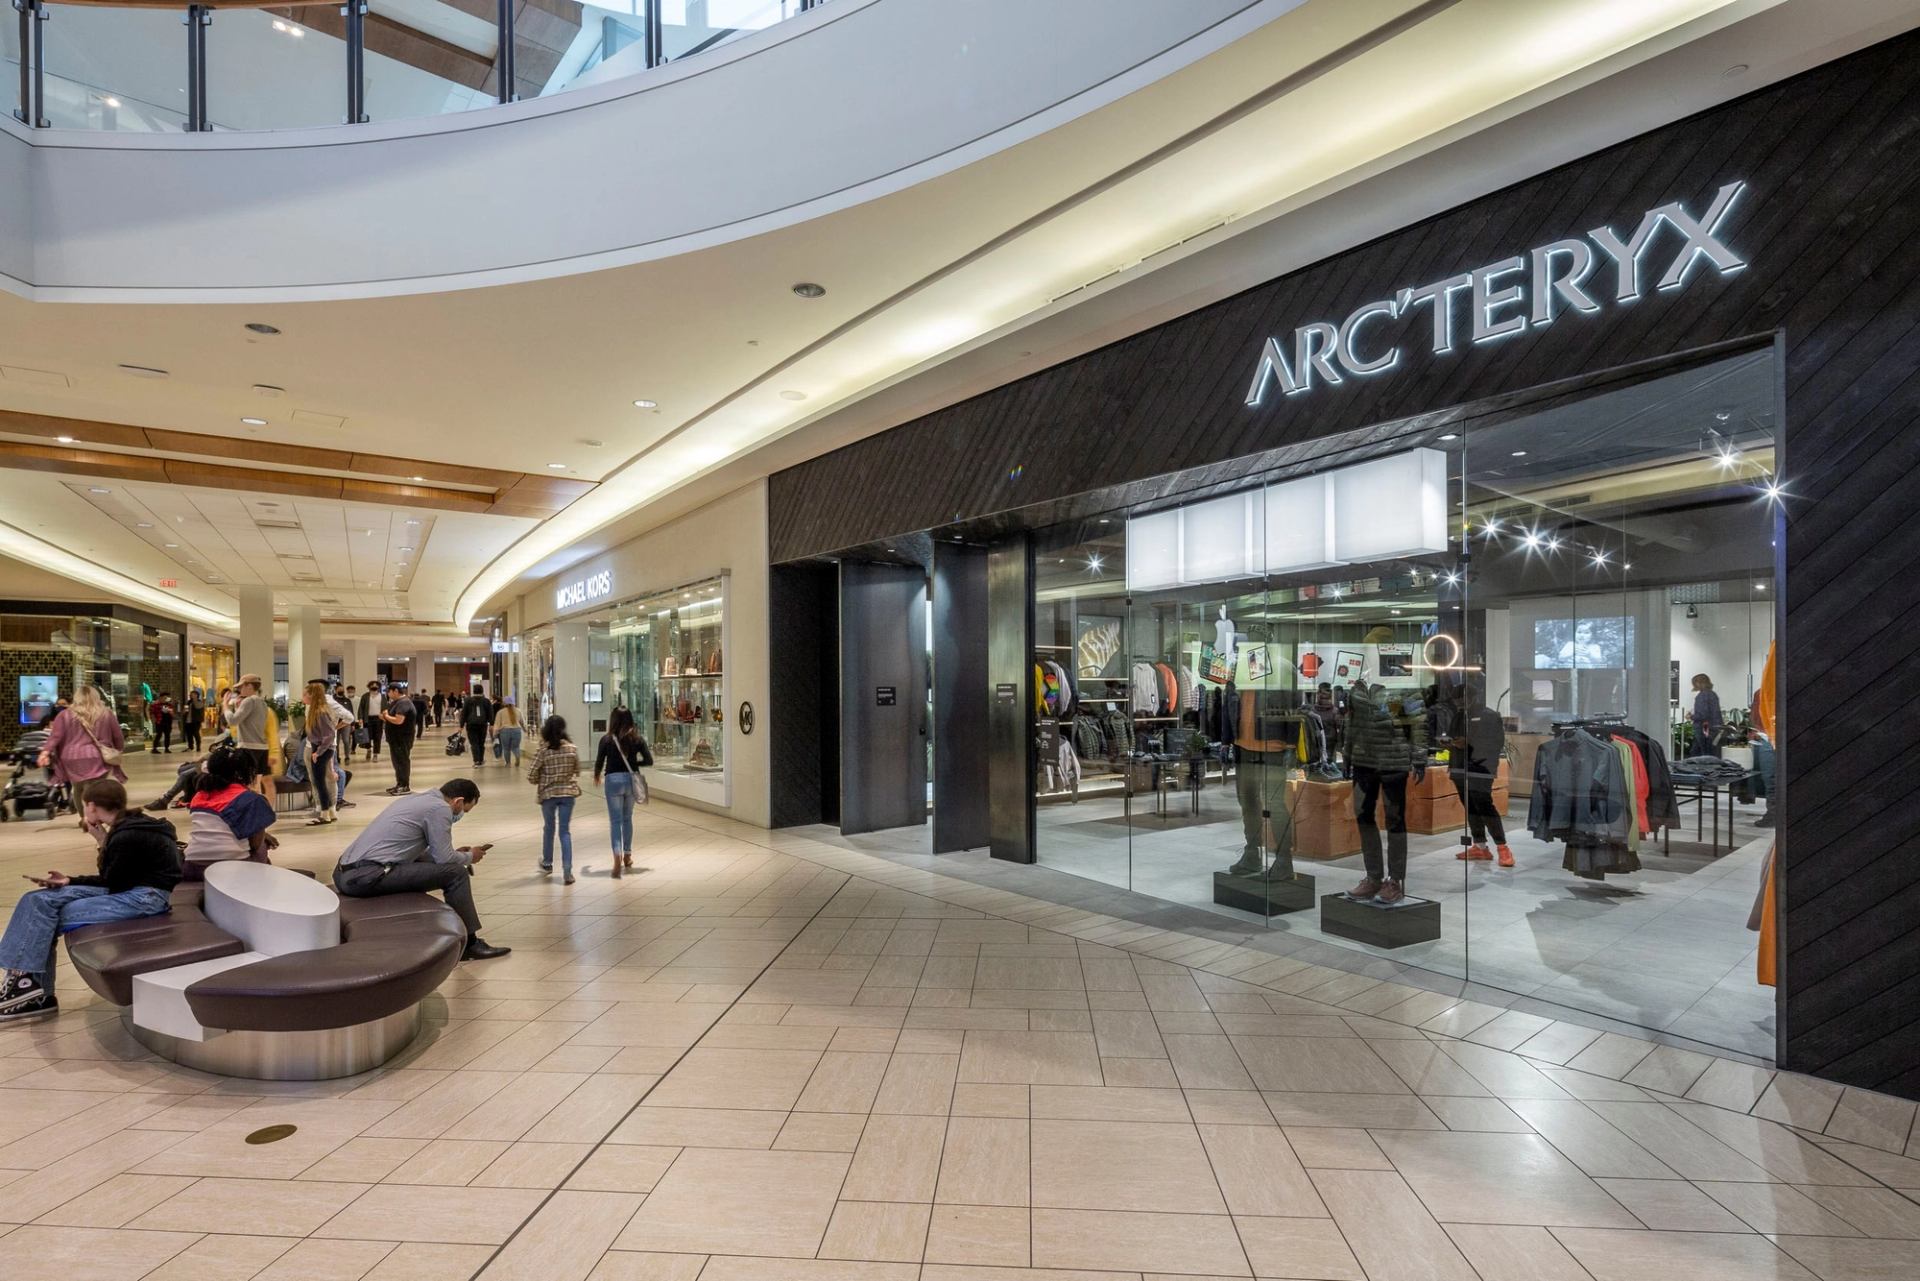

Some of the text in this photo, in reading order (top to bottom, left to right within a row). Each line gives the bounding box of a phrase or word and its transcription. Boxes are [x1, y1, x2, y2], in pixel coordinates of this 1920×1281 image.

[1244, 180, 1748, 406] ARC'TERYX
[557, 570, 611, 609] MICHAEL KORS
